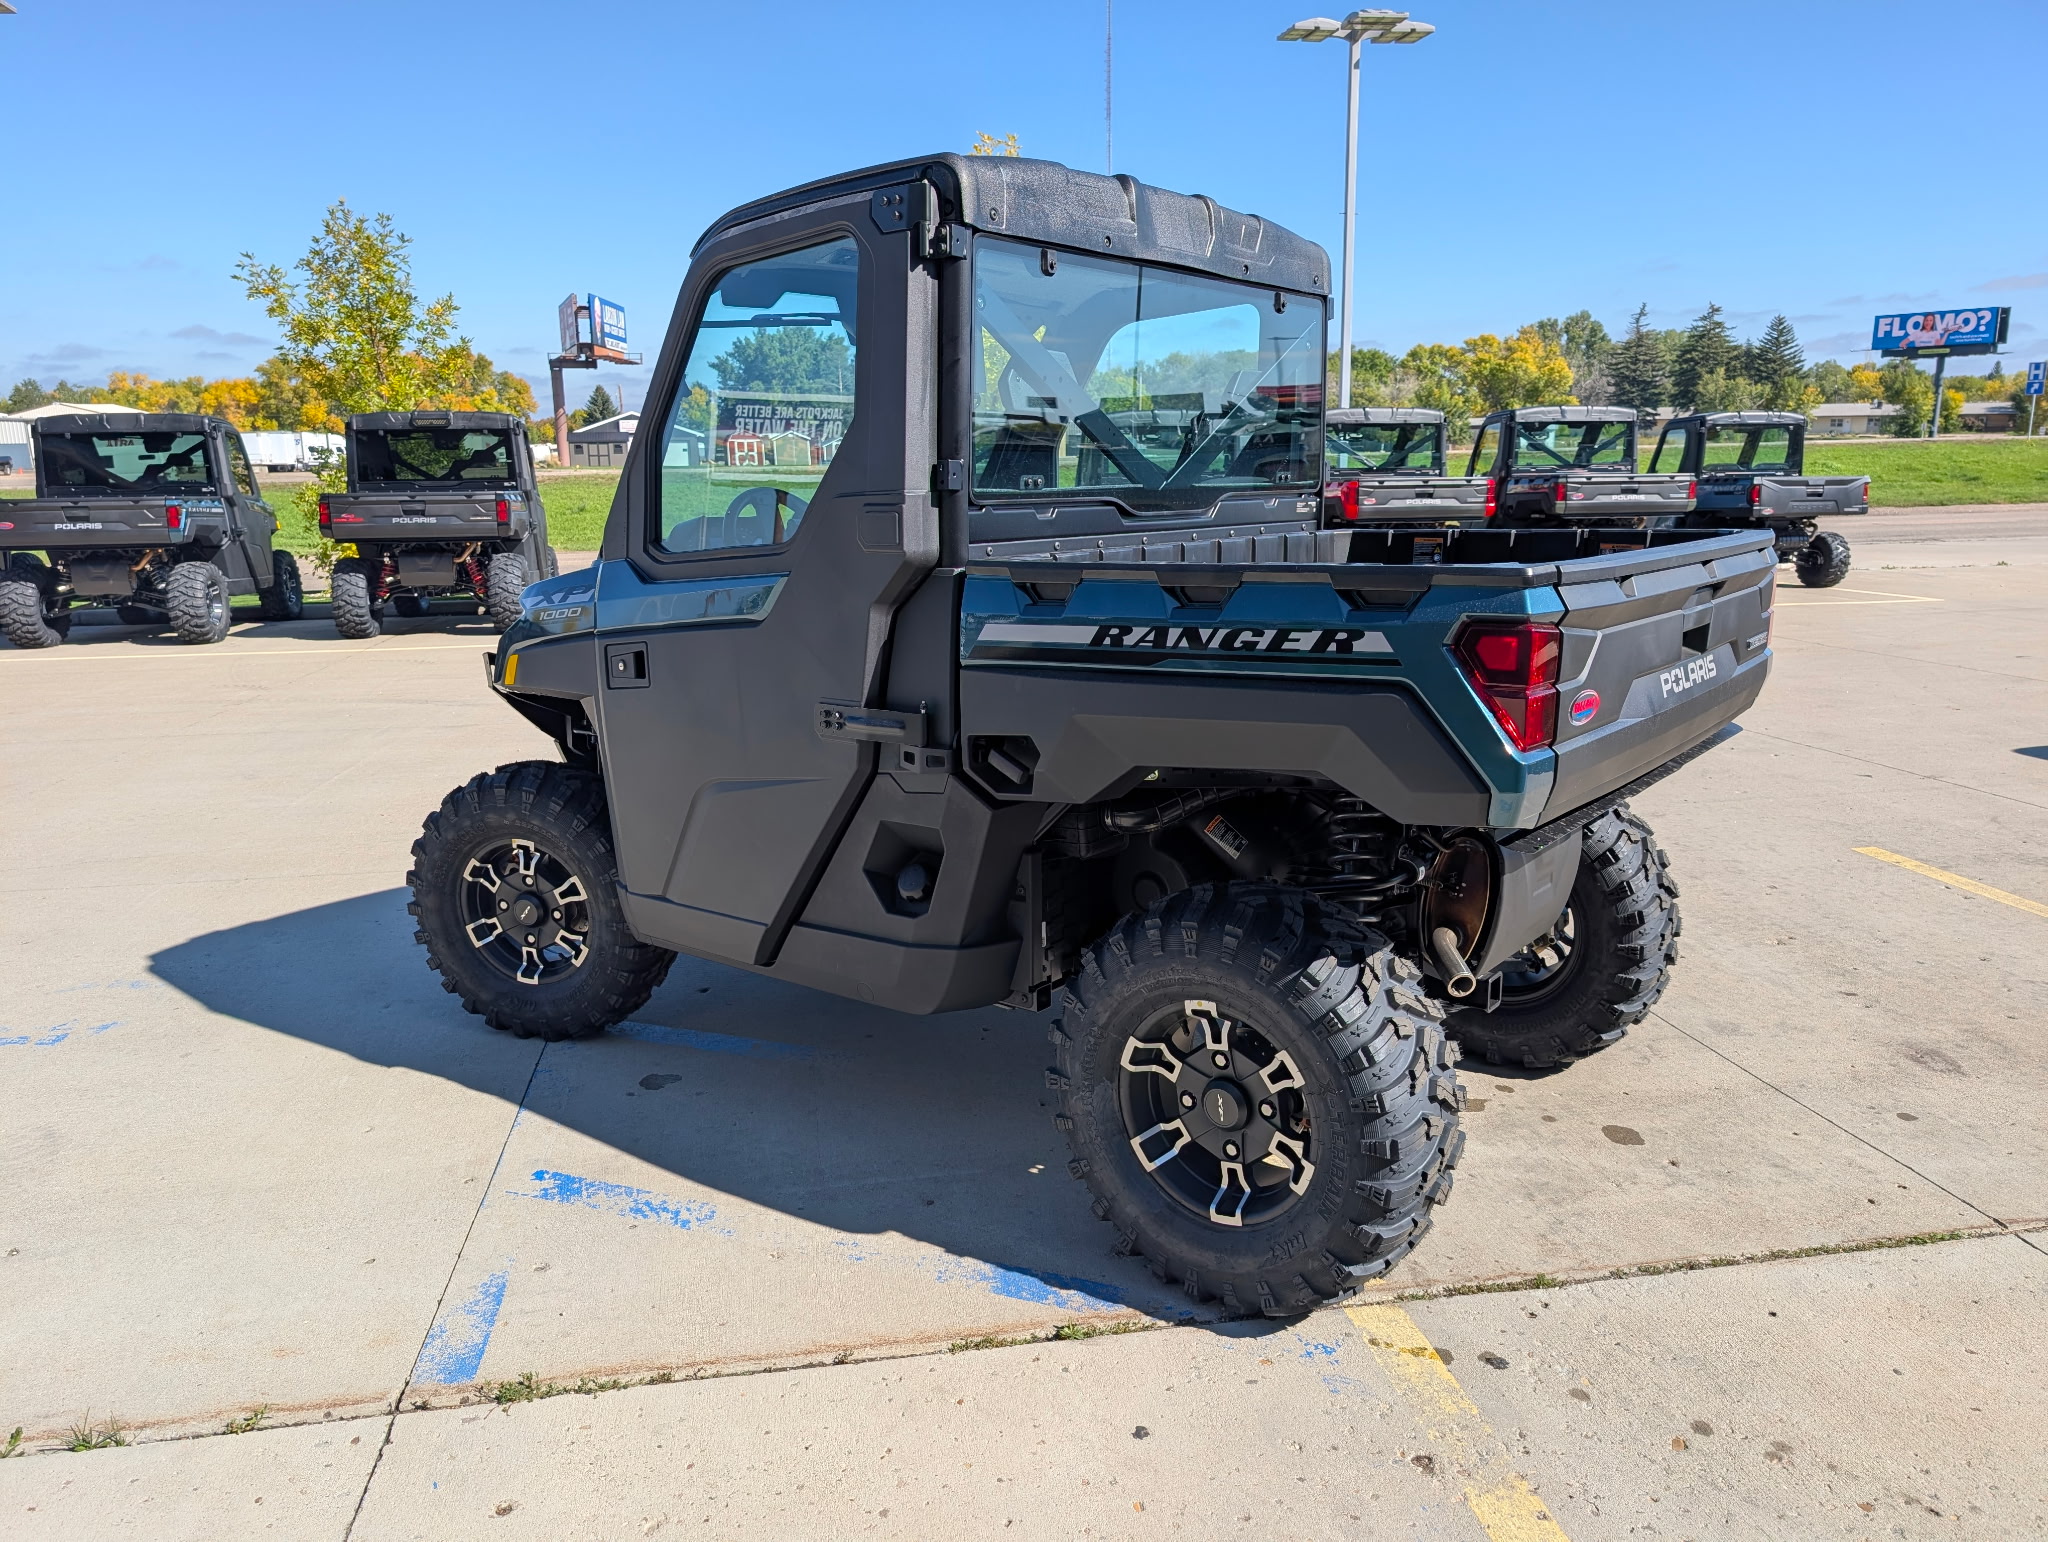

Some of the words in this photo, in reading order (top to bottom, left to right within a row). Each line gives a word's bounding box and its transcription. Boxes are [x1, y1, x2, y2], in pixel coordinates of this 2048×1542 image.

[2030, 363, 2046, 380] H
[54, 522, 103, 530] POLARIS
[530, 584, 595, 608] XP
[539, 607, 582, 621] 1000
[1088, 624, 1366, 655] RANGER
[1660, 654, 1717, 699] POLARIS
